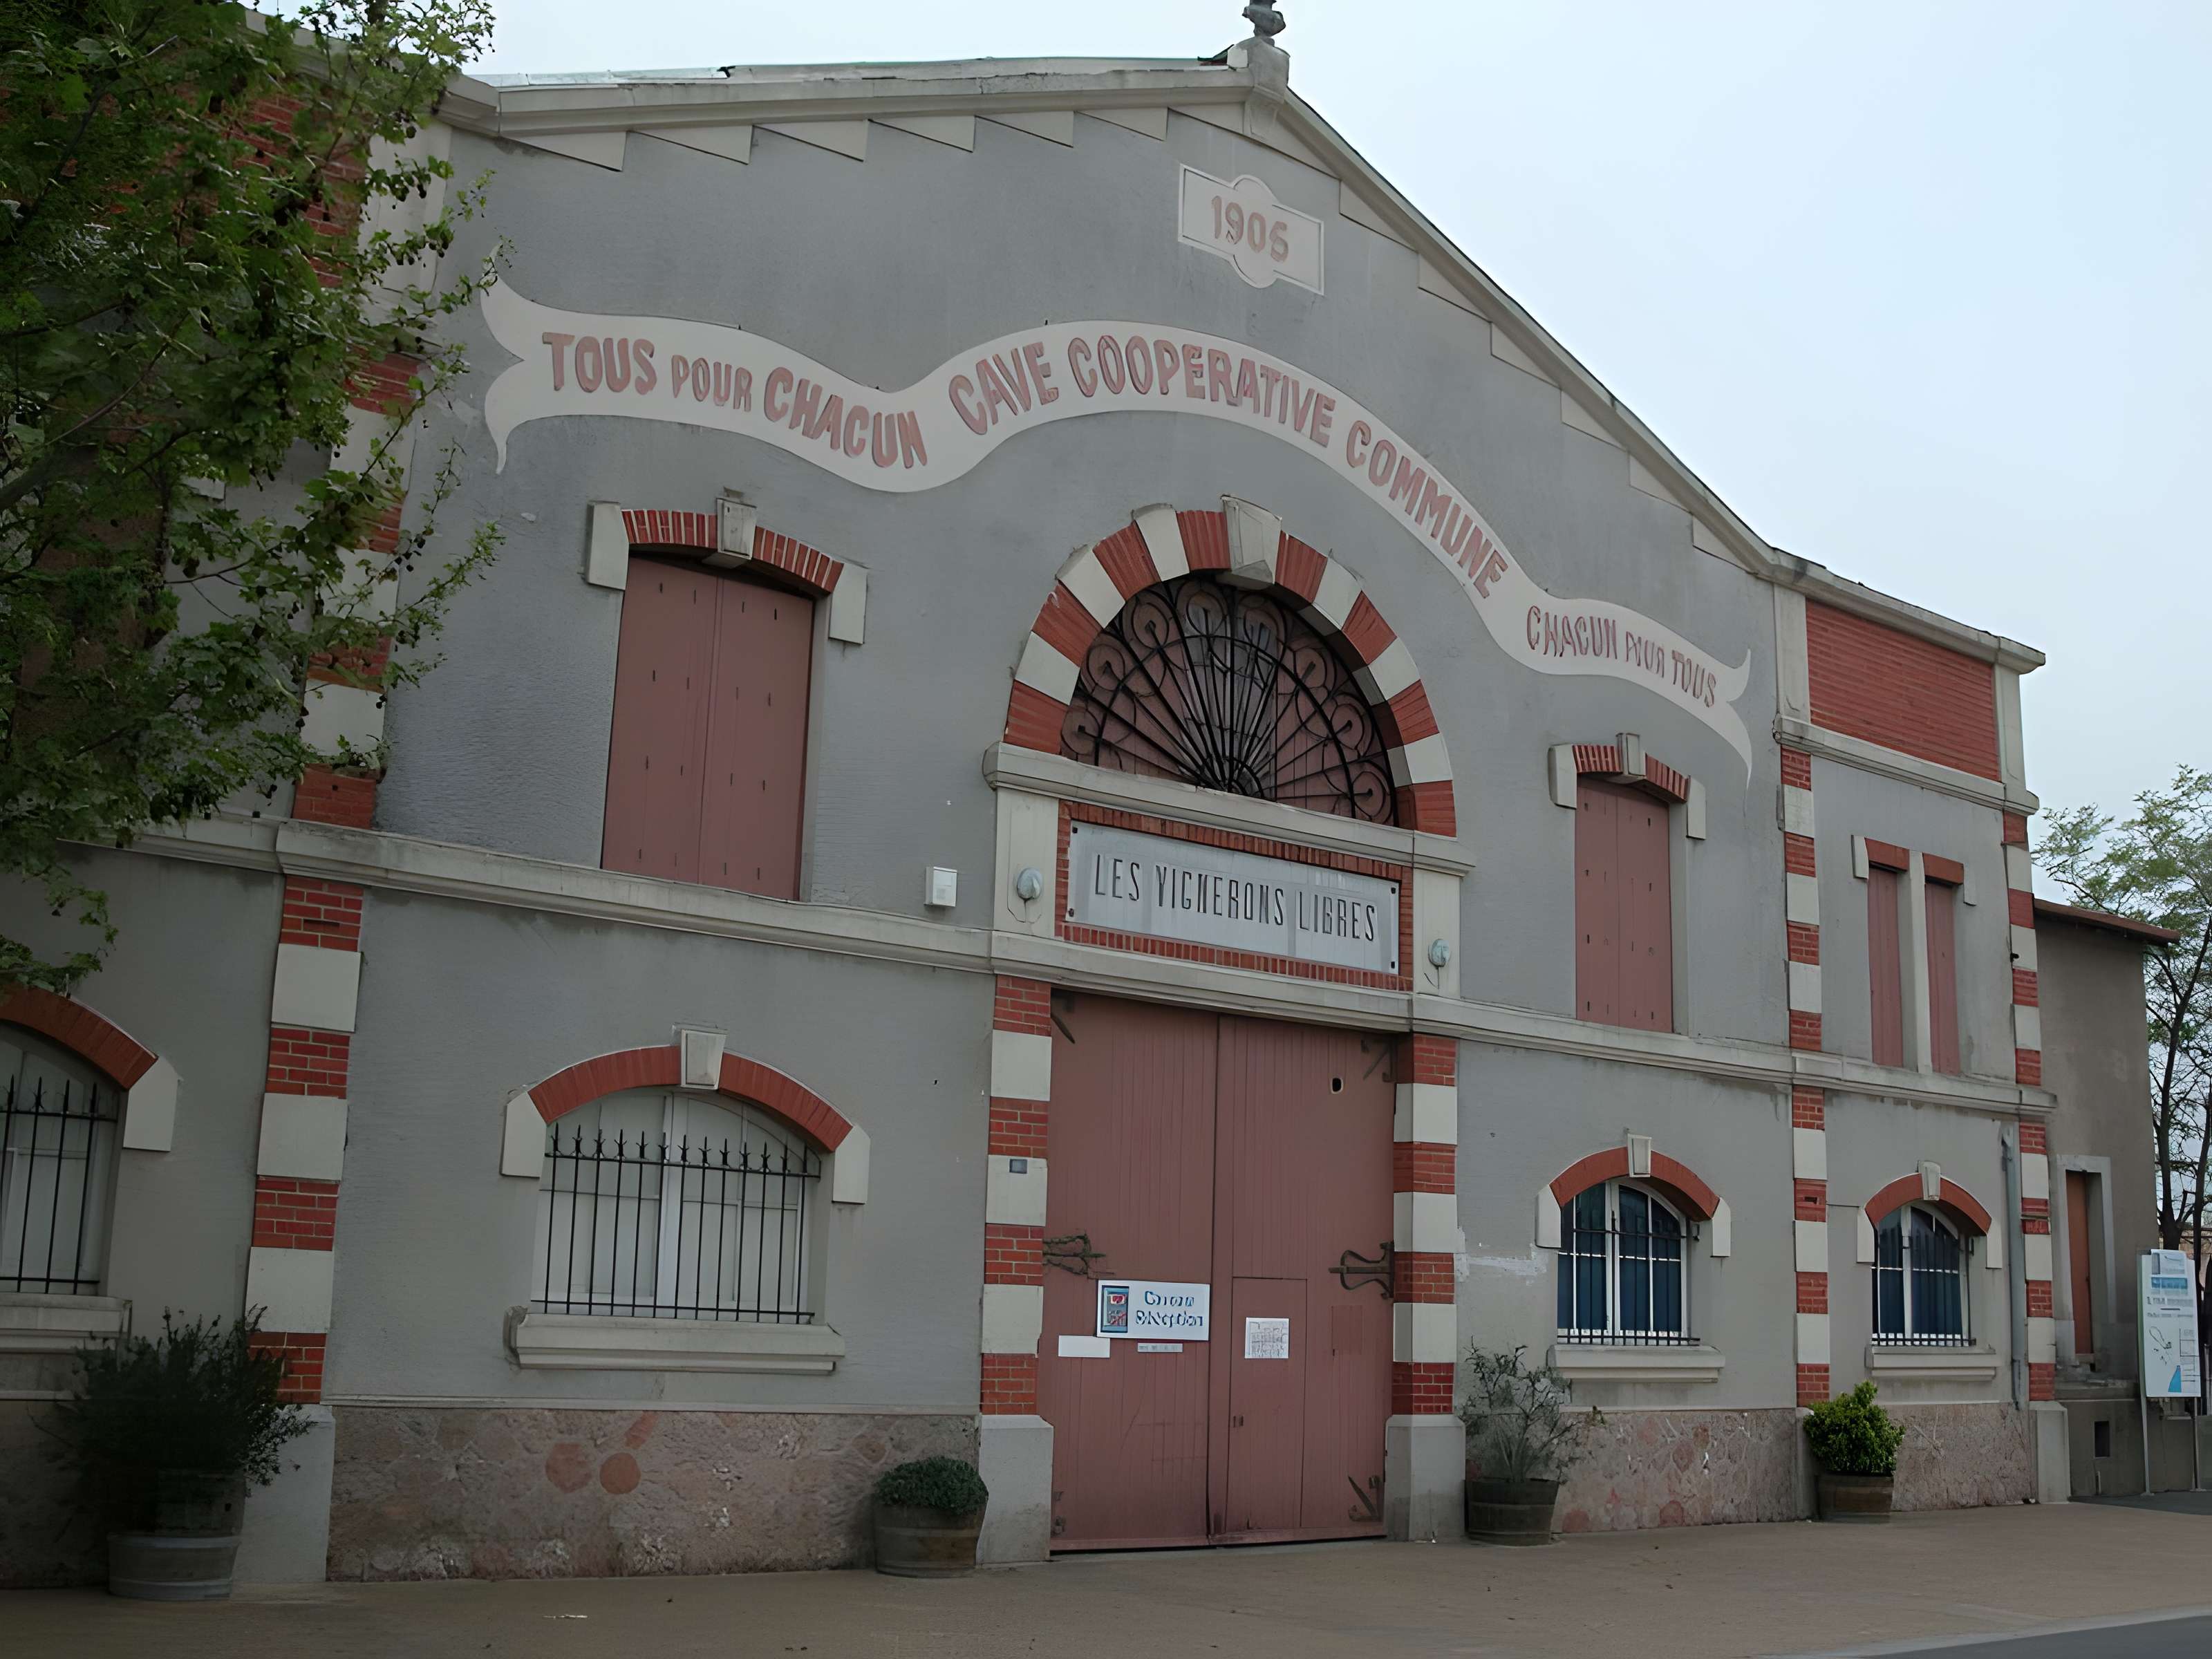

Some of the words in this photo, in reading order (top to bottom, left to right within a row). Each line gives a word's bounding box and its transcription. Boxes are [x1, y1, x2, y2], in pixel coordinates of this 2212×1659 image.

[542, 332, 657, 395] TOUS
[671, 355, 752, 412] POUR
[764, 366, 928, 469] CHACUN
[948, 341, 1060, 435] CAVE
[1067, 335, 1336, 448] COOPERATIVE
[1347, 420, 1510, 600] COMMUNE
[1526, 605, 1618, 659] CHACUN
[1671, 649, 1717, 708] TOUS
[1094, 854, 1141, 902] LES
[1297, 890, 1376, 942] LIBRES
